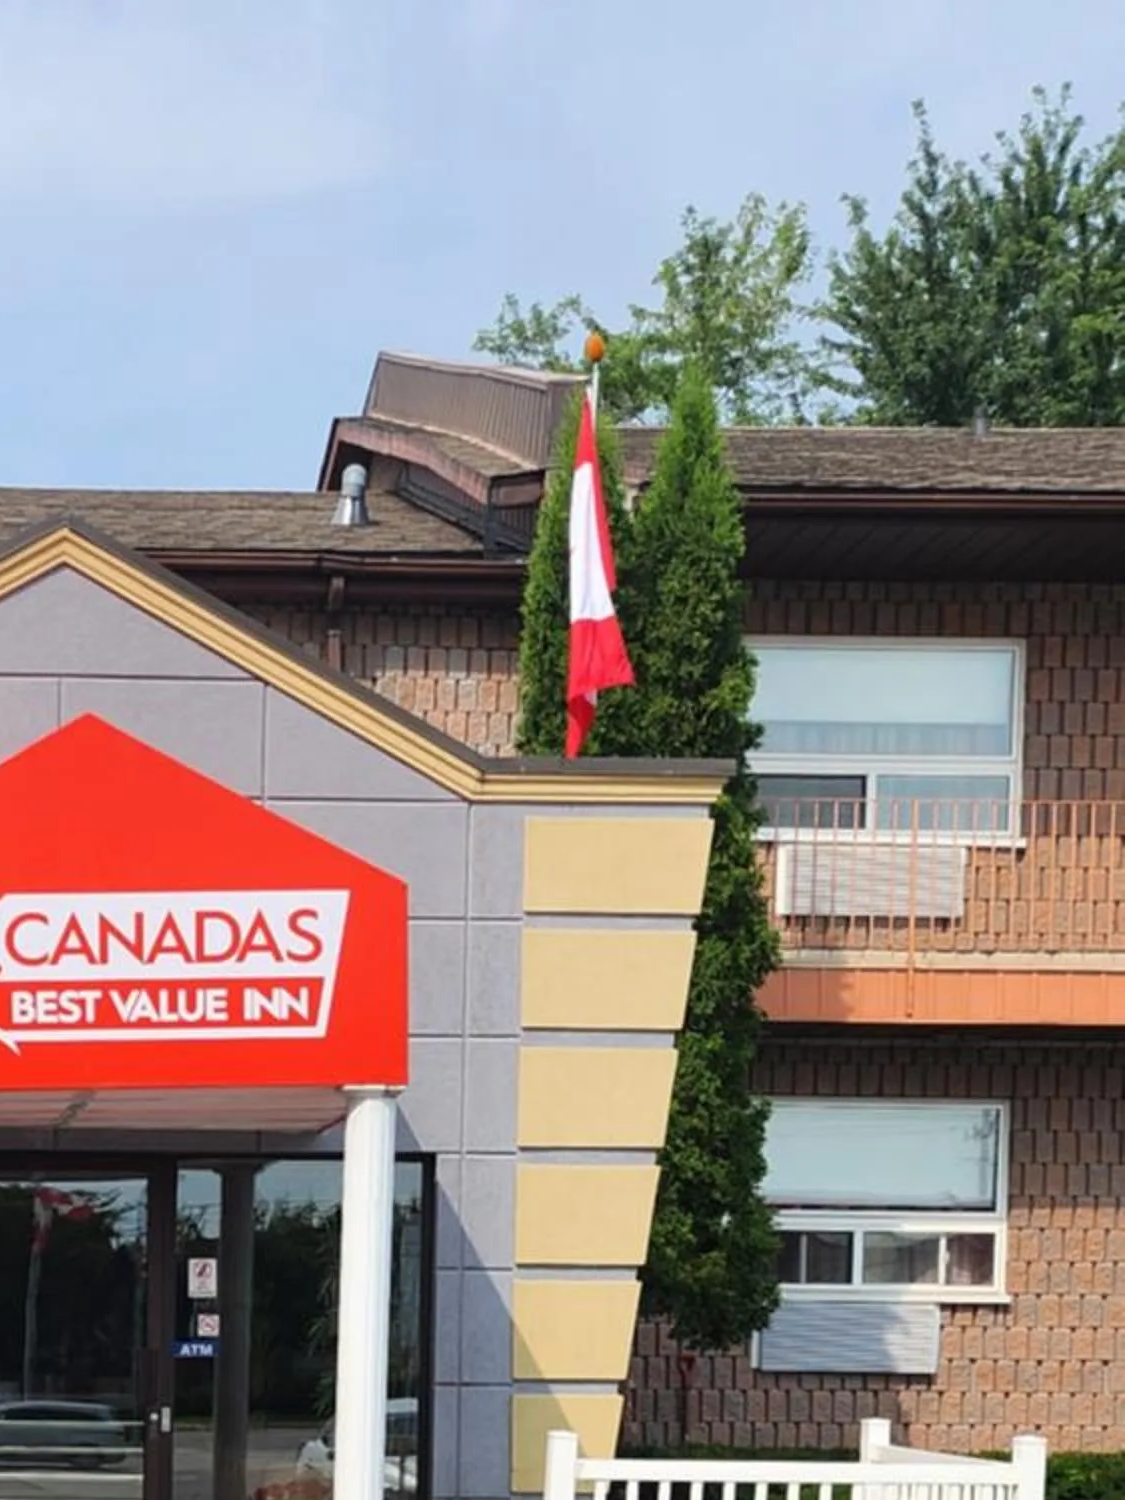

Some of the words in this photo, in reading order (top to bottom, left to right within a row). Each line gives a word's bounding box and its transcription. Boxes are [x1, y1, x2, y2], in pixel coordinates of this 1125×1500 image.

[5, 910, 323, 966] CANADAS
[11, 990, 101, 1024] BEST
[110, 989, 228, 1021] VALUE
[244, 986, 309, 1020] INN
[180, 1344, 213, 1356] ATM
